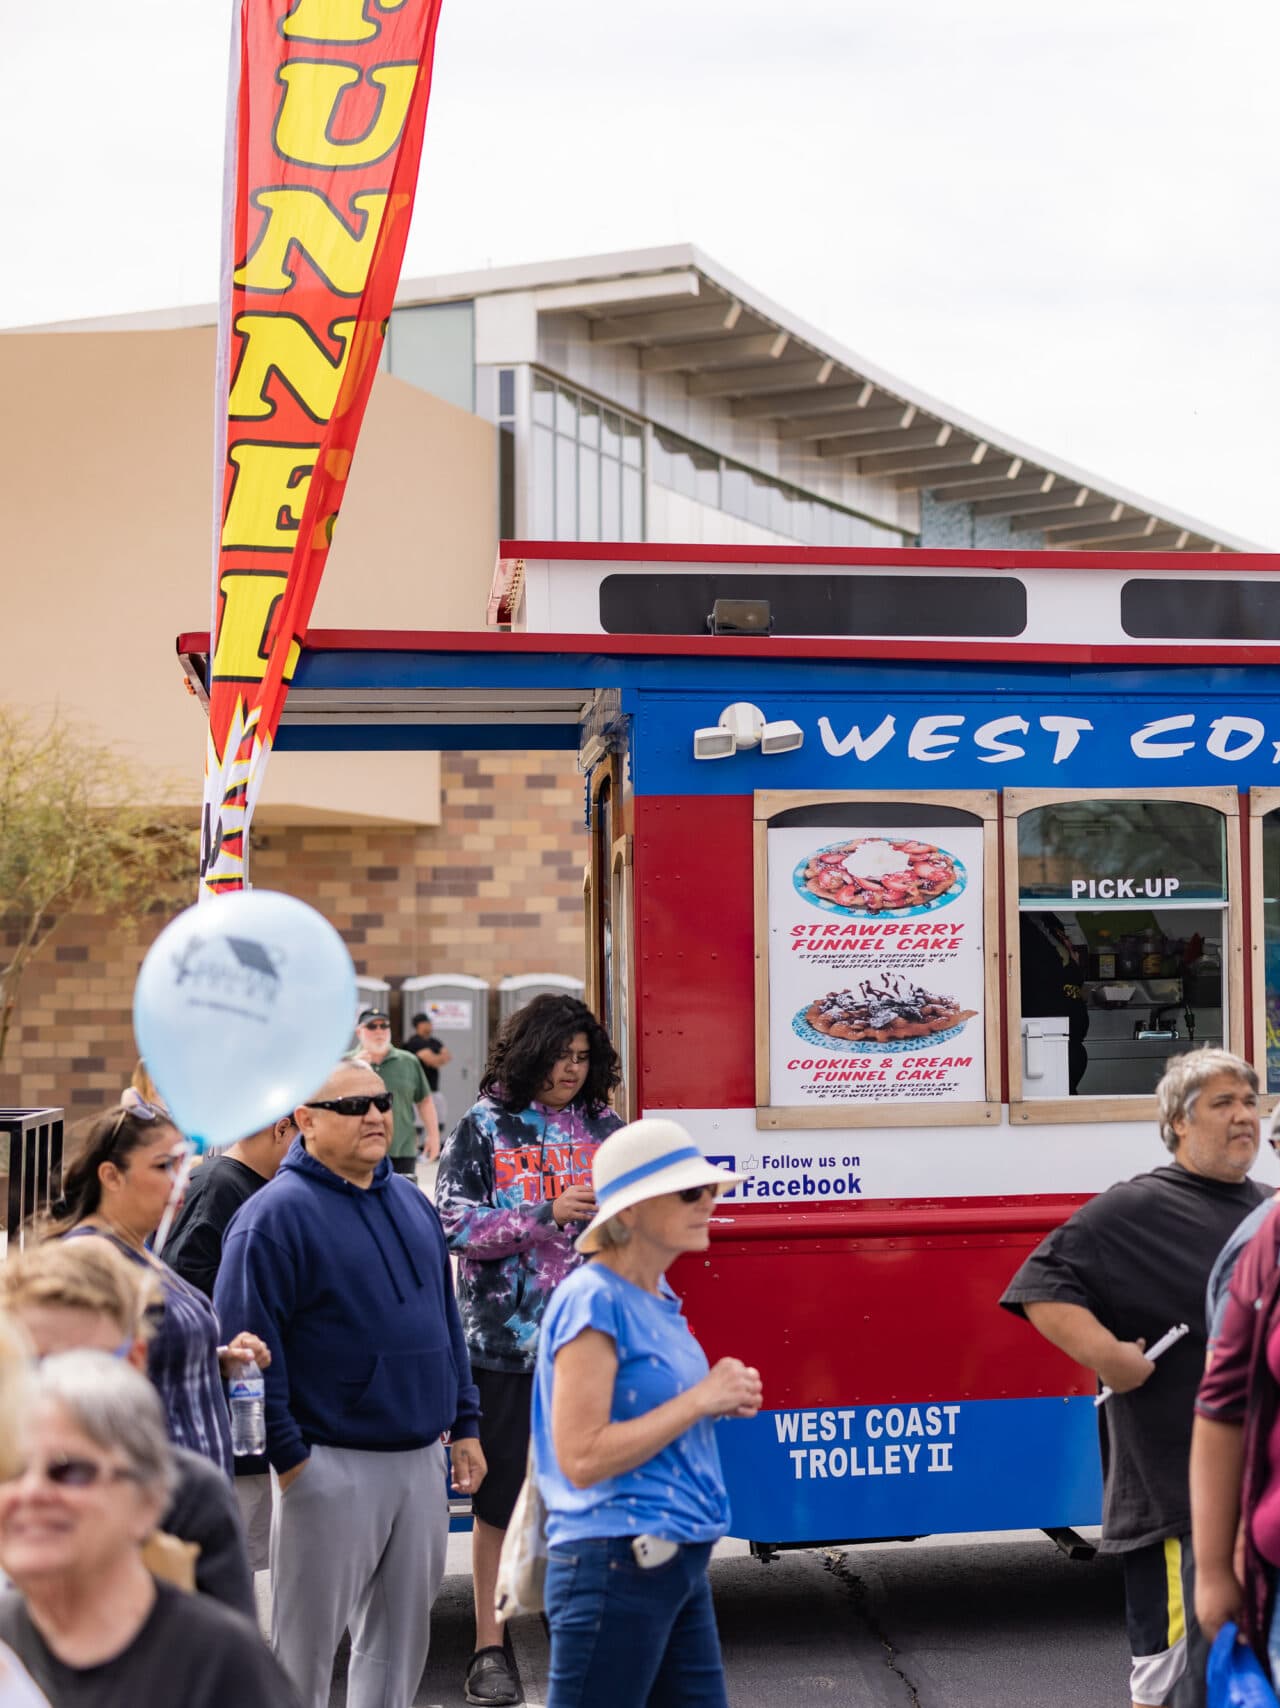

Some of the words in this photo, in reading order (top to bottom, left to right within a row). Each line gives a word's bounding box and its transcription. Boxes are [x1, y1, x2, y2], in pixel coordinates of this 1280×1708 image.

[818, 713, 1094, 764] WEST
[1070, 877, 1181, 899] PICK-UP
[790, 923, 965, 937] STRAWBERRY
[791, 938, 885, 951] FUNNEL
[896, 938, 963, 950] CAKE
[787, 1058, 872, 1070] COOKIES
[879, 1057, 893, 1068] &
[902, 1057, 973, 1068] CREAM
[812, 1070, 886, 1082] FUNNEL
[895, 1069, 948, 1081] CAKE
[495, 1147, 597, 1184] STRANG
[762, 1155, 813, 1169] Follow
[819, 1156, 836, 1168] us
[842, 1156, 860, 1167] on
[742, 1173, 862, 1197] Facebook
[774, 1410, 856, 1443] WEST
[865, 1405, 961, 1439] COAST
[789, 1444, 921, 1480] TROLLEY
[927, 1443, 953, 1472] II
